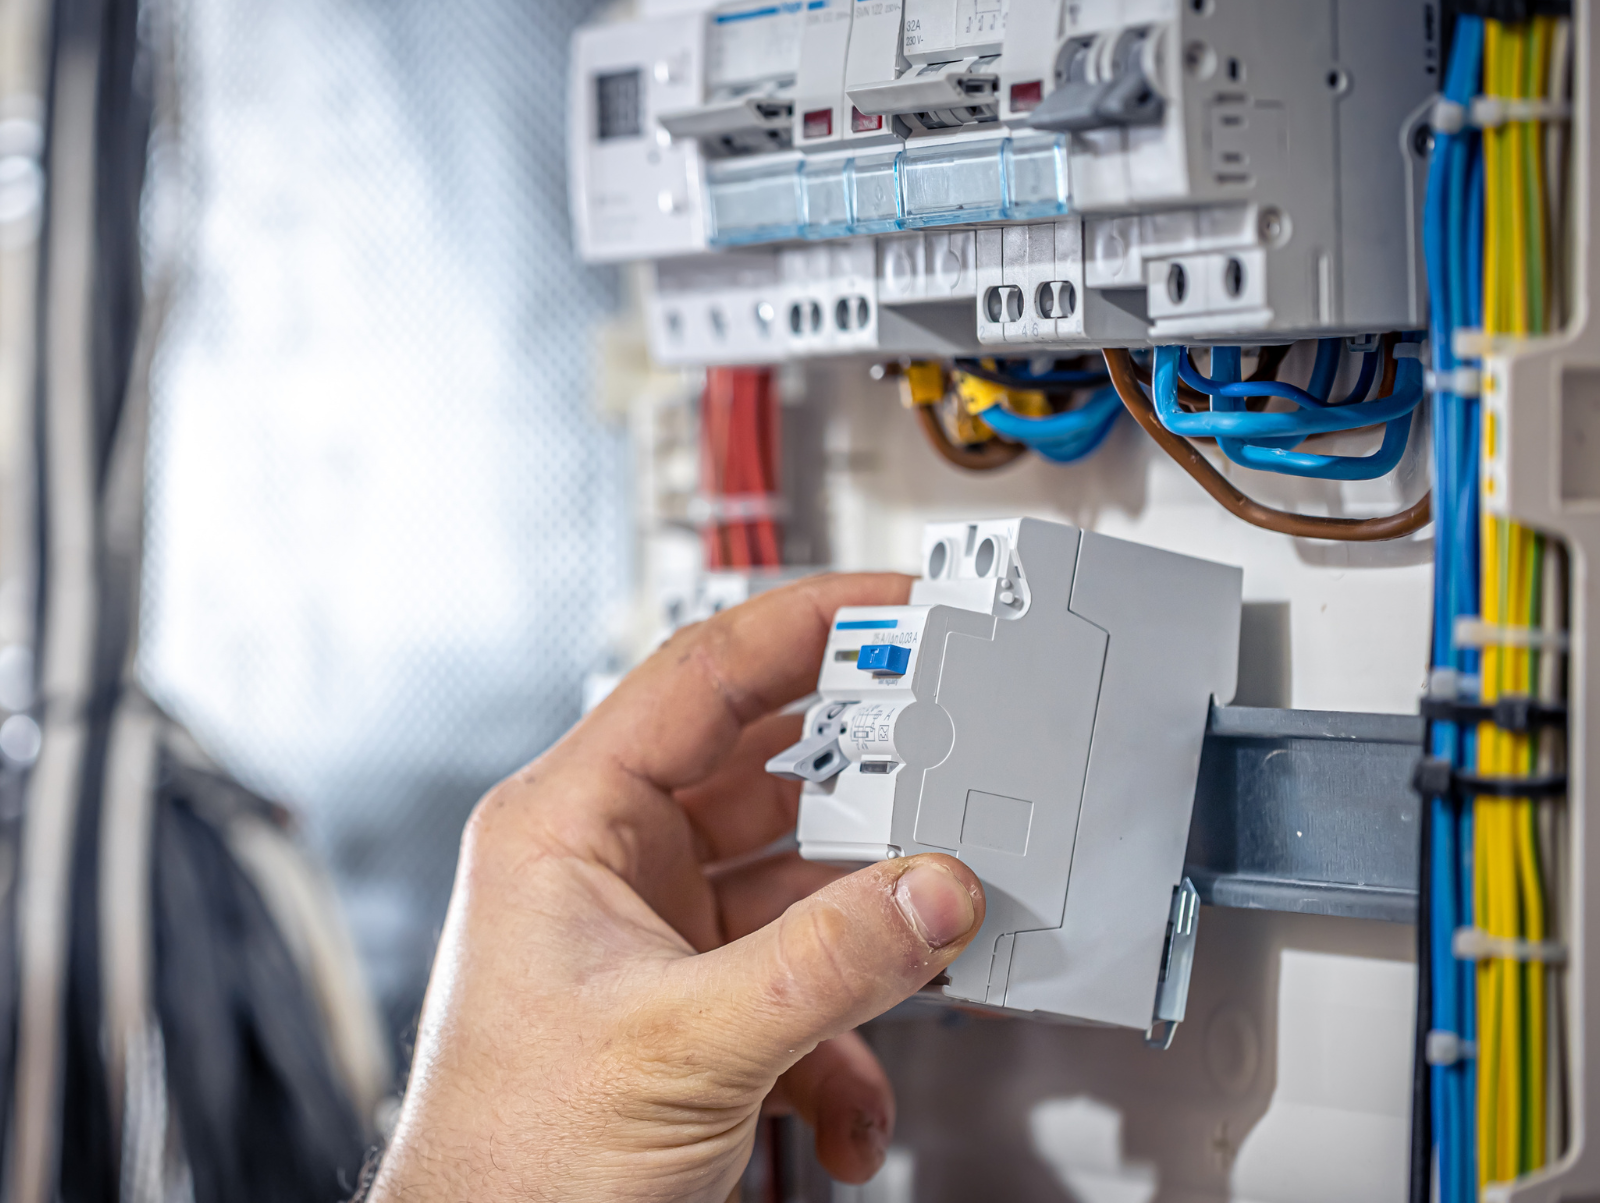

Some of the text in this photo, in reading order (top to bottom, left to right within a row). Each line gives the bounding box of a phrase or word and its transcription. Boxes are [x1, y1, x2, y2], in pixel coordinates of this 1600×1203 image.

[906, 36, 916, 46] 230
[1022, 322, 1038, 338] 4 6
